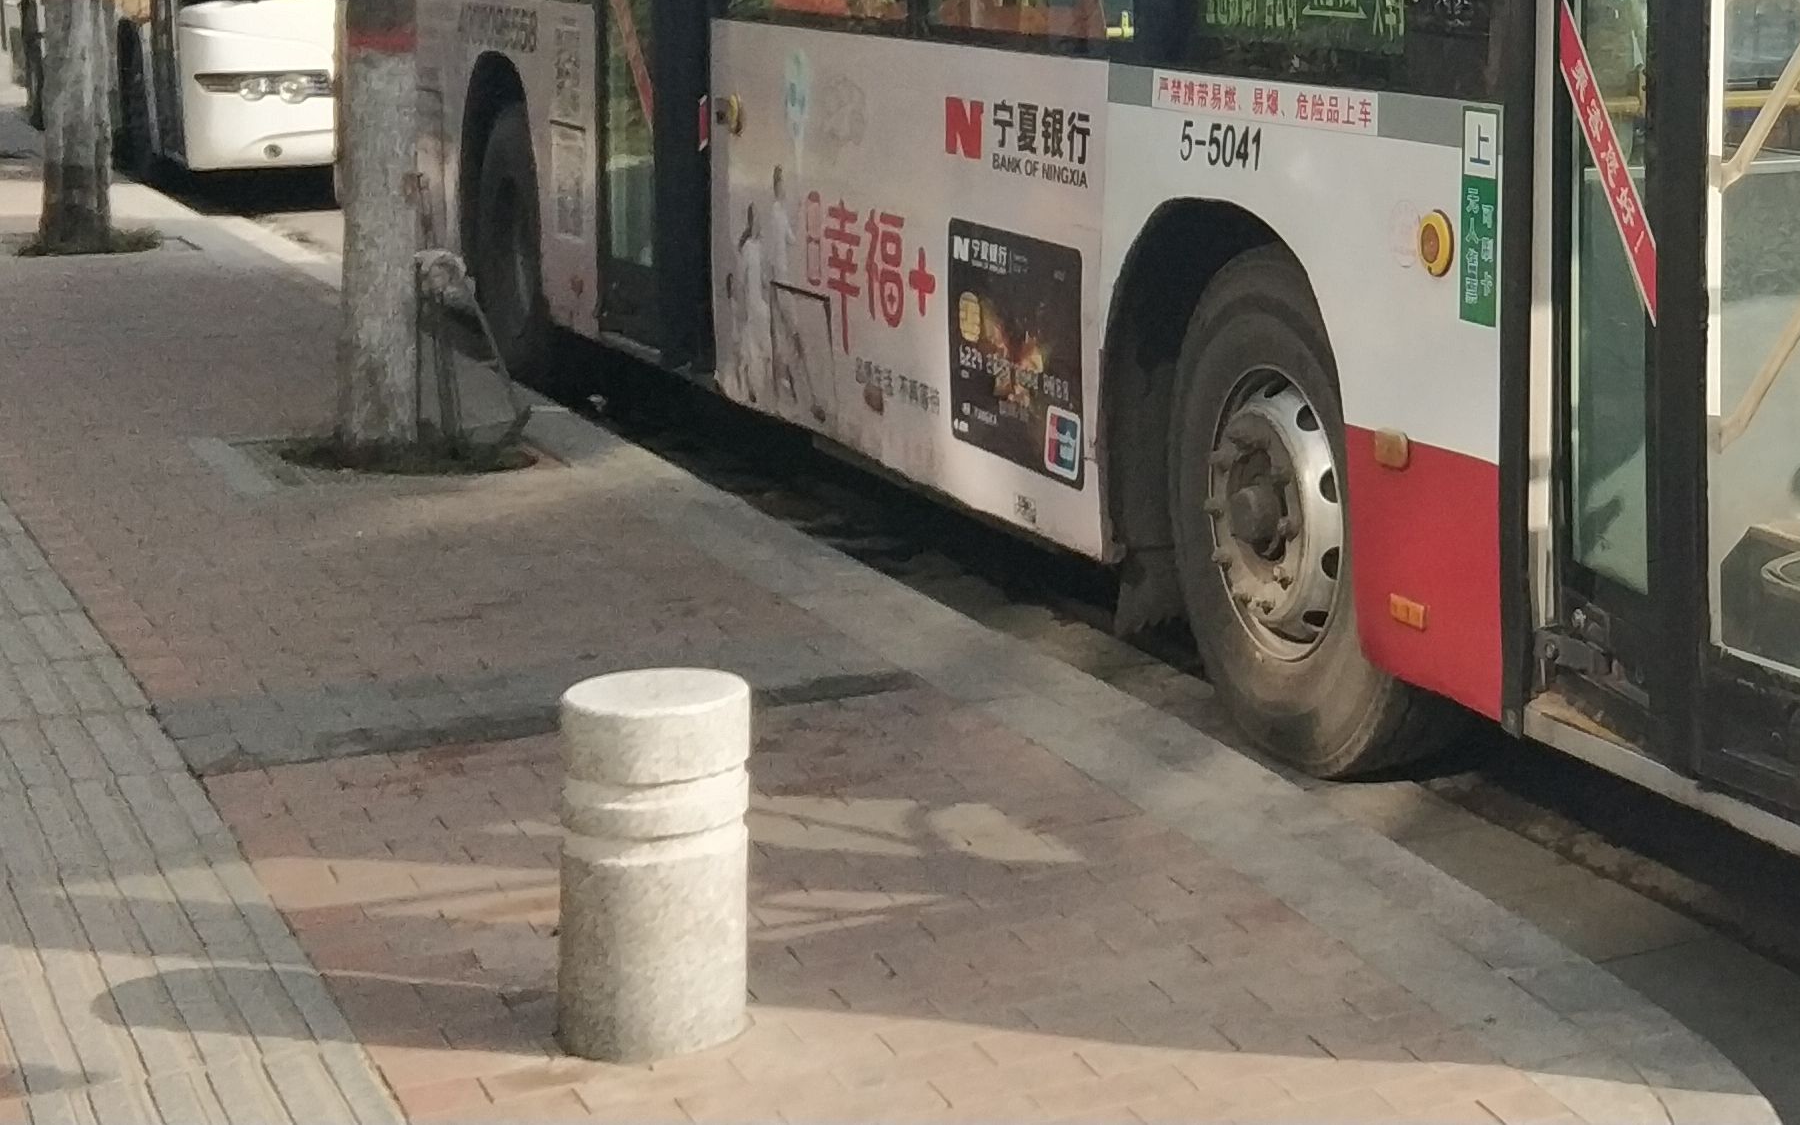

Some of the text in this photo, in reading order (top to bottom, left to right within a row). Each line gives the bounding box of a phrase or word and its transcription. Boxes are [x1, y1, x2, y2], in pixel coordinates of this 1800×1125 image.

[992, 99, 1092, 165] 宁夏银行
[1179, 120, 1262, 172] 5-5041
[1469, 124, 1491, 166] 上
[992, 152, 1088, 189] BANK OF NINGXIA
[1465, 187, 1480, 305] 无人售票
